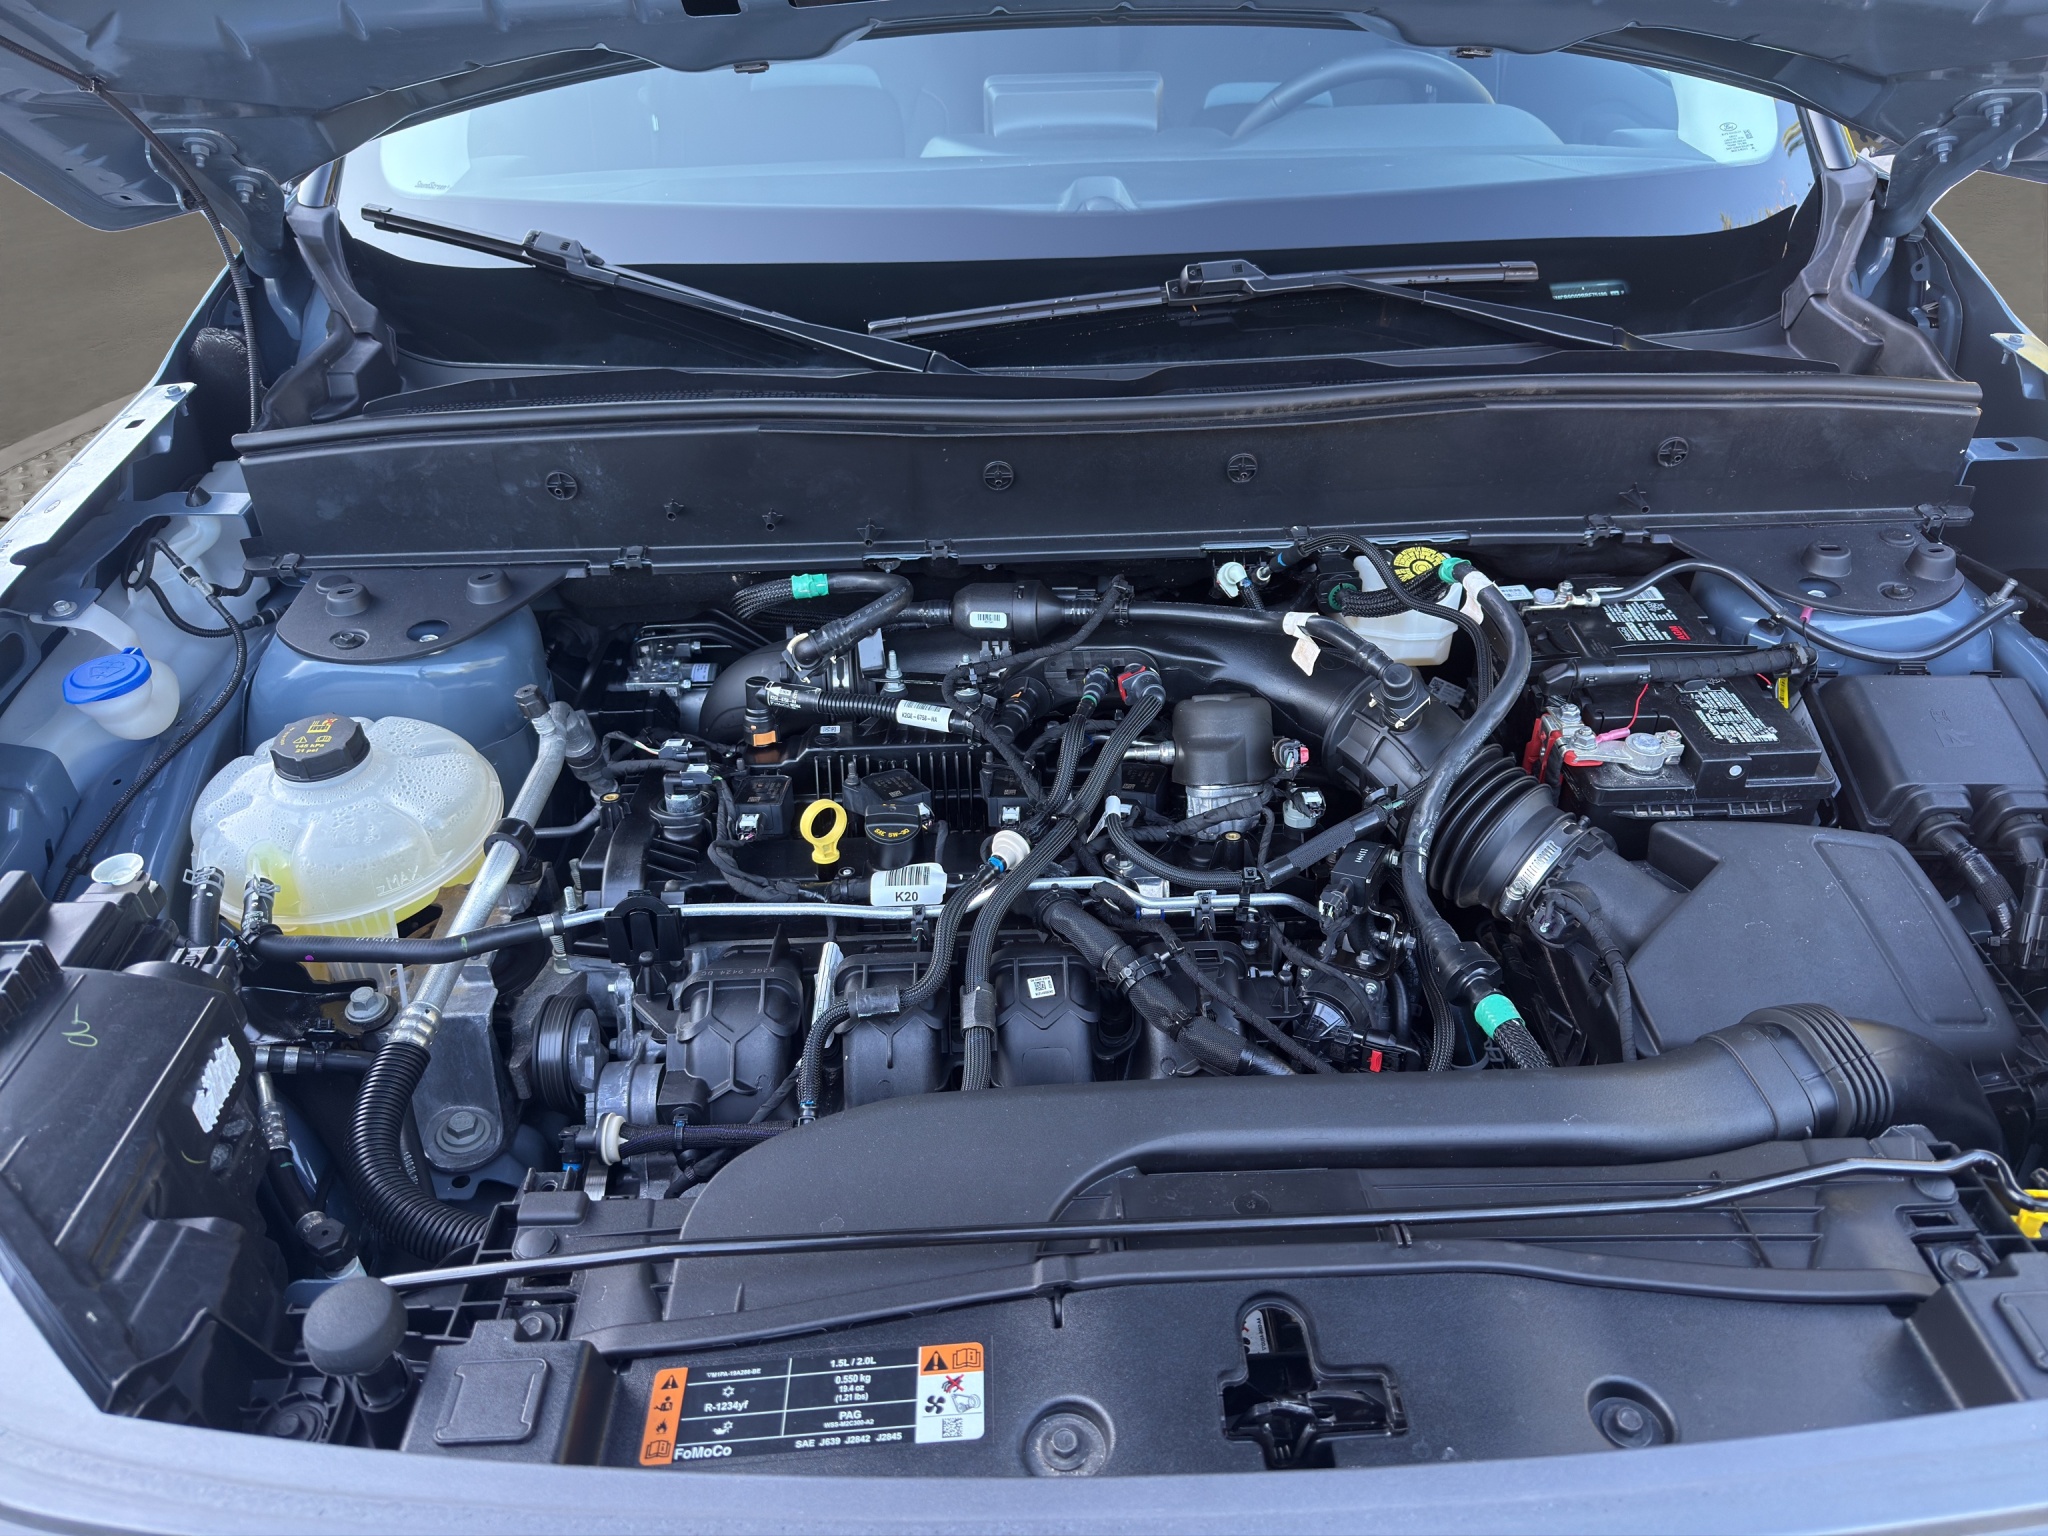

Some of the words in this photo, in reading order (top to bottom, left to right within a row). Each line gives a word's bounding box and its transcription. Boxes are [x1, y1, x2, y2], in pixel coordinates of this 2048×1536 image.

[874, 828, 887, 837] SAE
[888, 828, 910, 838] 5W-30
[895, 891, 919, 902] K20
[830, 1358, 850, 1367] 1.5L
[857, 1357, 877, 1366] 2.0L
[834, 1375, 859, 1385] 0.550
[860, 1374, 872, 1384] kg
[834, 1394, 852, 1404] (1.21
[853, 1393, 869, 1402] lbs)
[704, 1400, 749, 1413] R-1234yf
[838, 1410, 862, 1420] PAG
[795, 1439, 816, 1449] SAE
[818, 1437, 841, 1447] J639
[844, 1435, 871, 1446] J2842
[876, 1432, 903, 1442] J2845
[674, 1445, 733, 1461] FoMoCo
